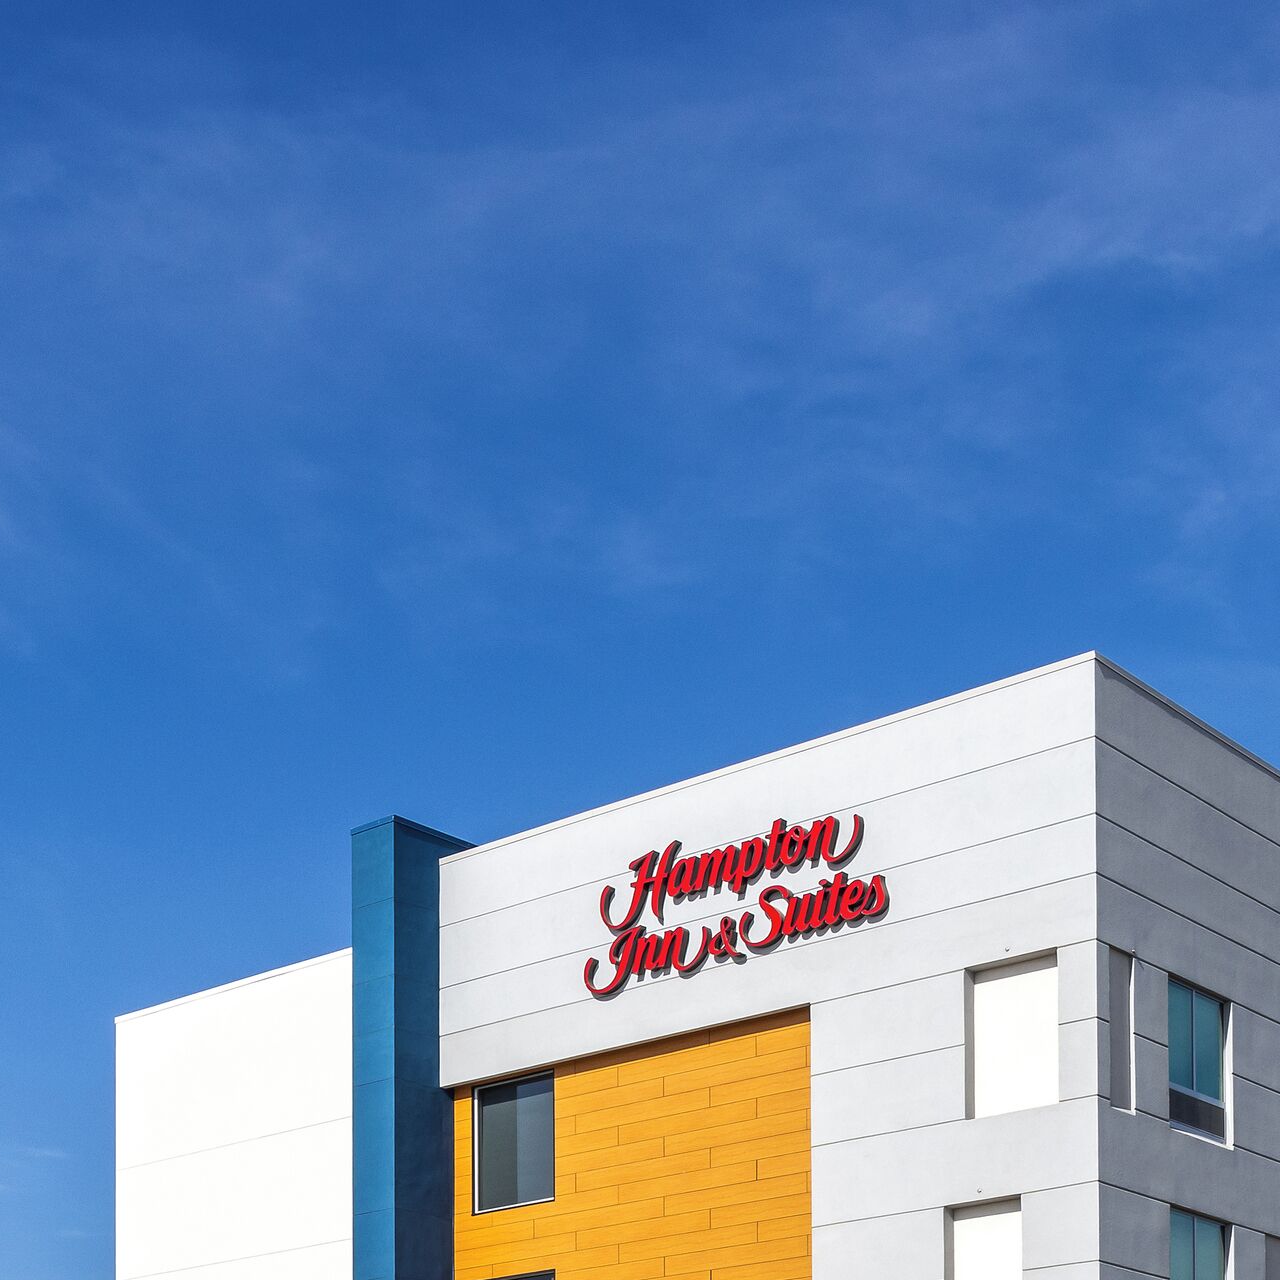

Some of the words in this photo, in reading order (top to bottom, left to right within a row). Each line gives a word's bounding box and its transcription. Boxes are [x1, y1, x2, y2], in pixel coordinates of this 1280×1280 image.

[584, 925, 712, 1000] Inn
[708, 916, 747, 964] &
[739, 872, 890, 955] Suites
[600, 814, 864, 936] Hampton
